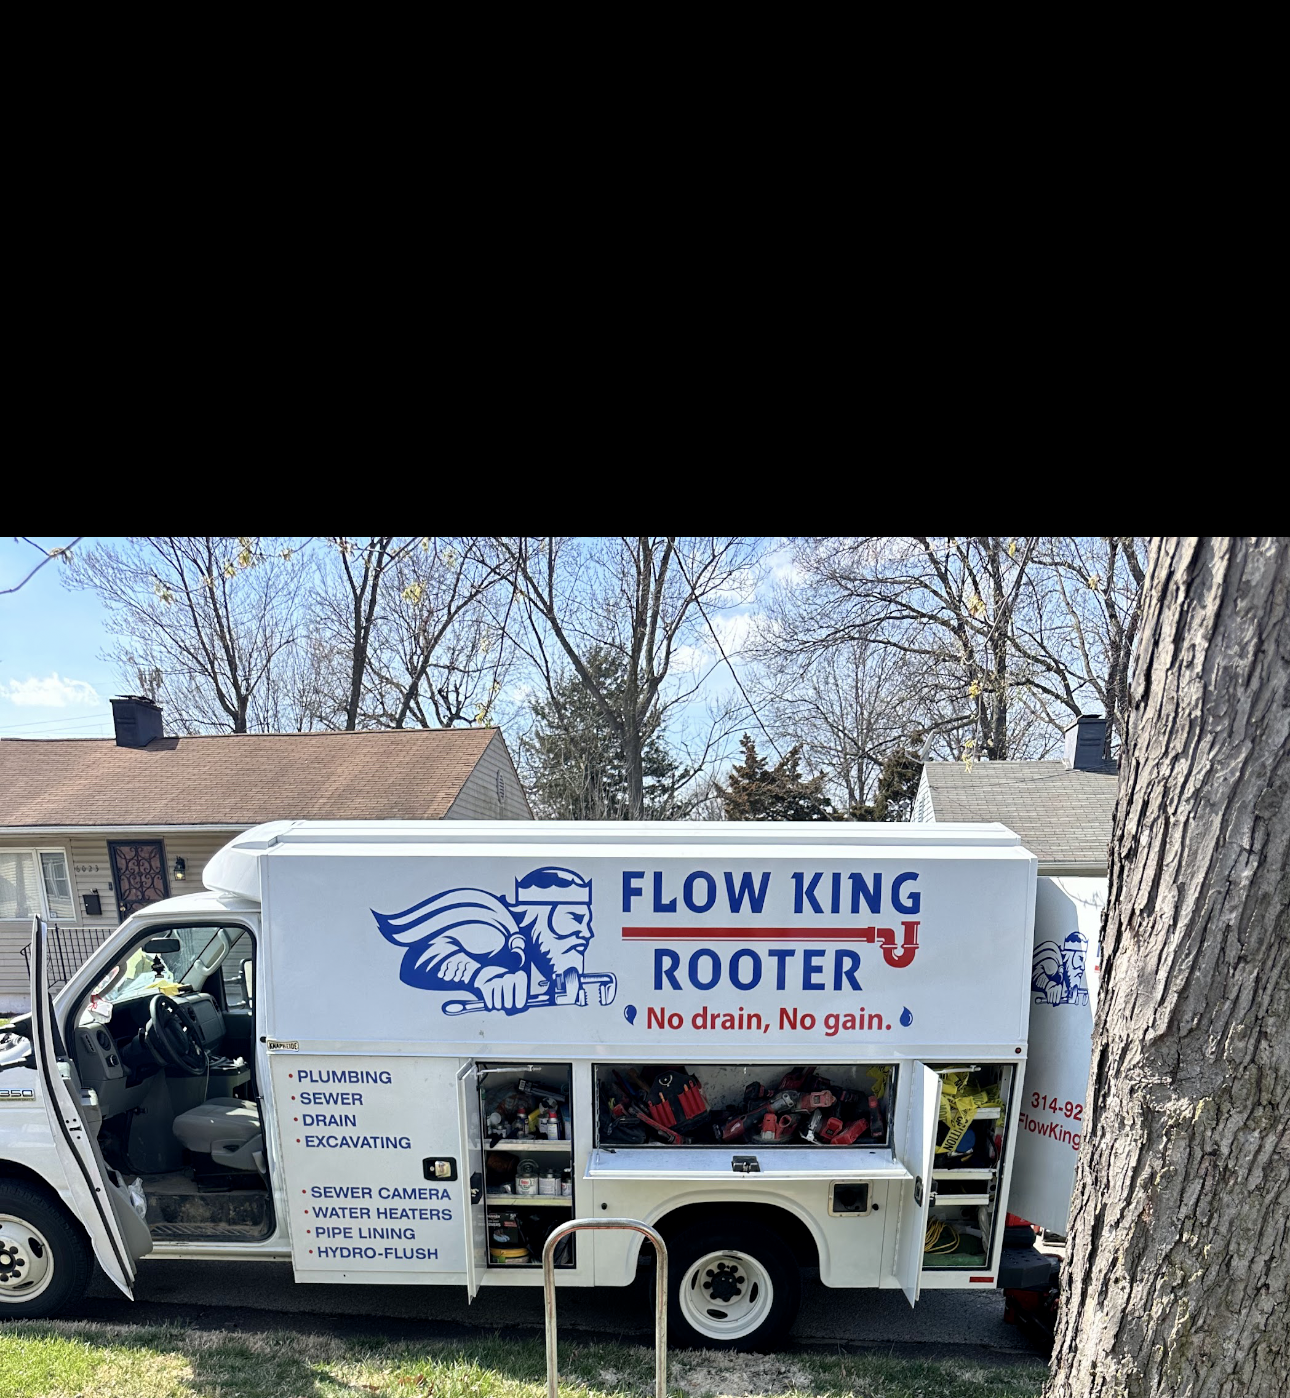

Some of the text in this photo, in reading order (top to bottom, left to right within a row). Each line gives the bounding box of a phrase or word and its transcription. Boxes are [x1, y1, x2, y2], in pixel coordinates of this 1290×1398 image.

[622, 871, 921, 914] FLOW KING
[653, 948, 863, 991] ROOTER
[646, 1006, 892, 1037] No drain, No gain.
[297, 1070, 392, 1084] PLUMBING
[300, 1092, 363, 1105] SEWER
[302, 1114, 357, 1127] DRAIN
[305, 1135, 411, 1149] EXCAVATING
[311, 1186, 451, 1200] SEWER CAMERA
[312, 1206, 453, 1221] WATER HEATERS
[315, 1227, 416, 1240] PIPE LINING
[317, 1246, 439, 1260] HYDRO-FLUSH
